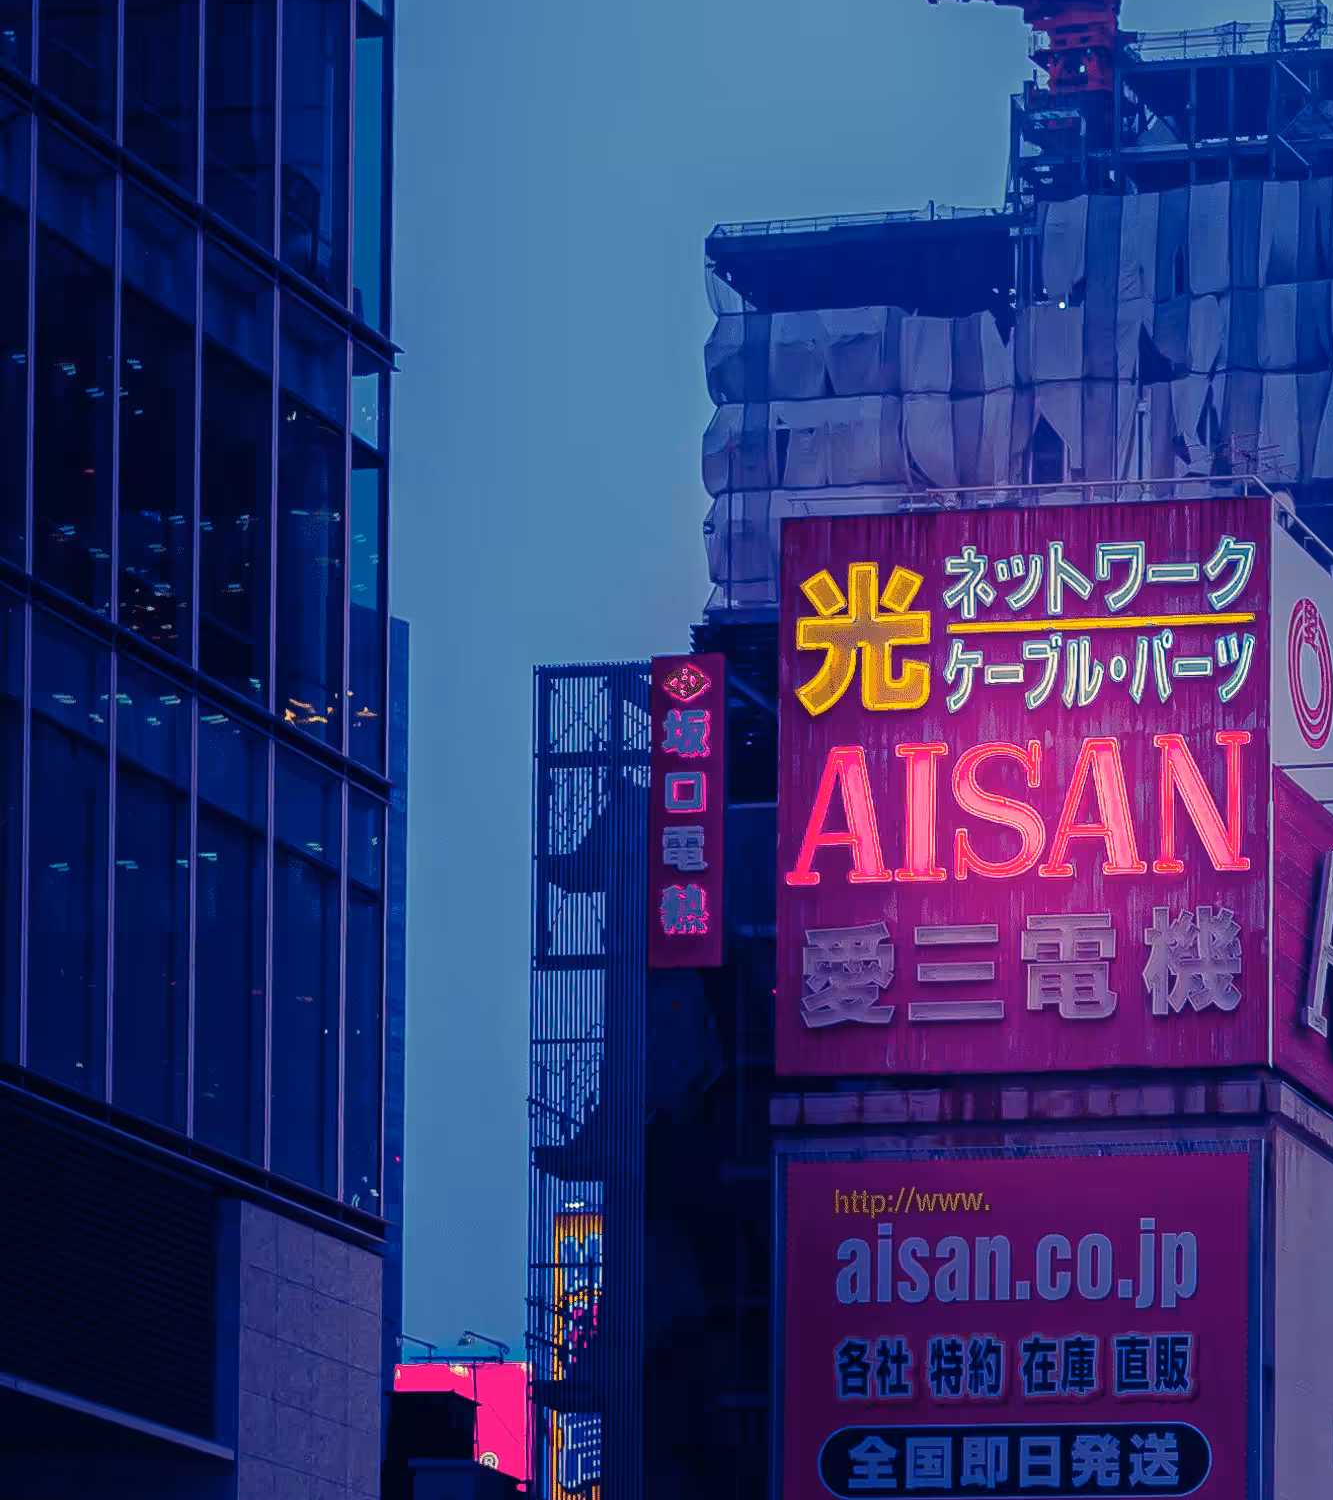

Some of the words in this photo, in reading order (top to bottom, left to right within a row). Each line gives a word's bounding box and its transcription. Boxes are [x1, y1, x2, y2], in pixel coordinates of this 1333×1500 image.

[944, 535, 1256, 619] ネットワーク
[796, 562, 931, 715] 光
[944, 632, 1256, 712] ケーブル・パーツ
[660, 708, 712, 937] 坂口電熱
[787, 730, 1251, 886] AISAN
[802, 905, 1243, 1028] 愛三電機
[834, 1187, 990, 1217] http://www.
[835, 1217, 1197, 1311] aisan.co.jp
[837, 1336, 912, 1401] 各社
[930, 1335, 1002, 1399] 特約
[1022, 1334, 1097, 1398] 在庫
[1114, 1333, 1192, 1397] 直販
[847, 1433, 1181, 1489] 全国即日発送
